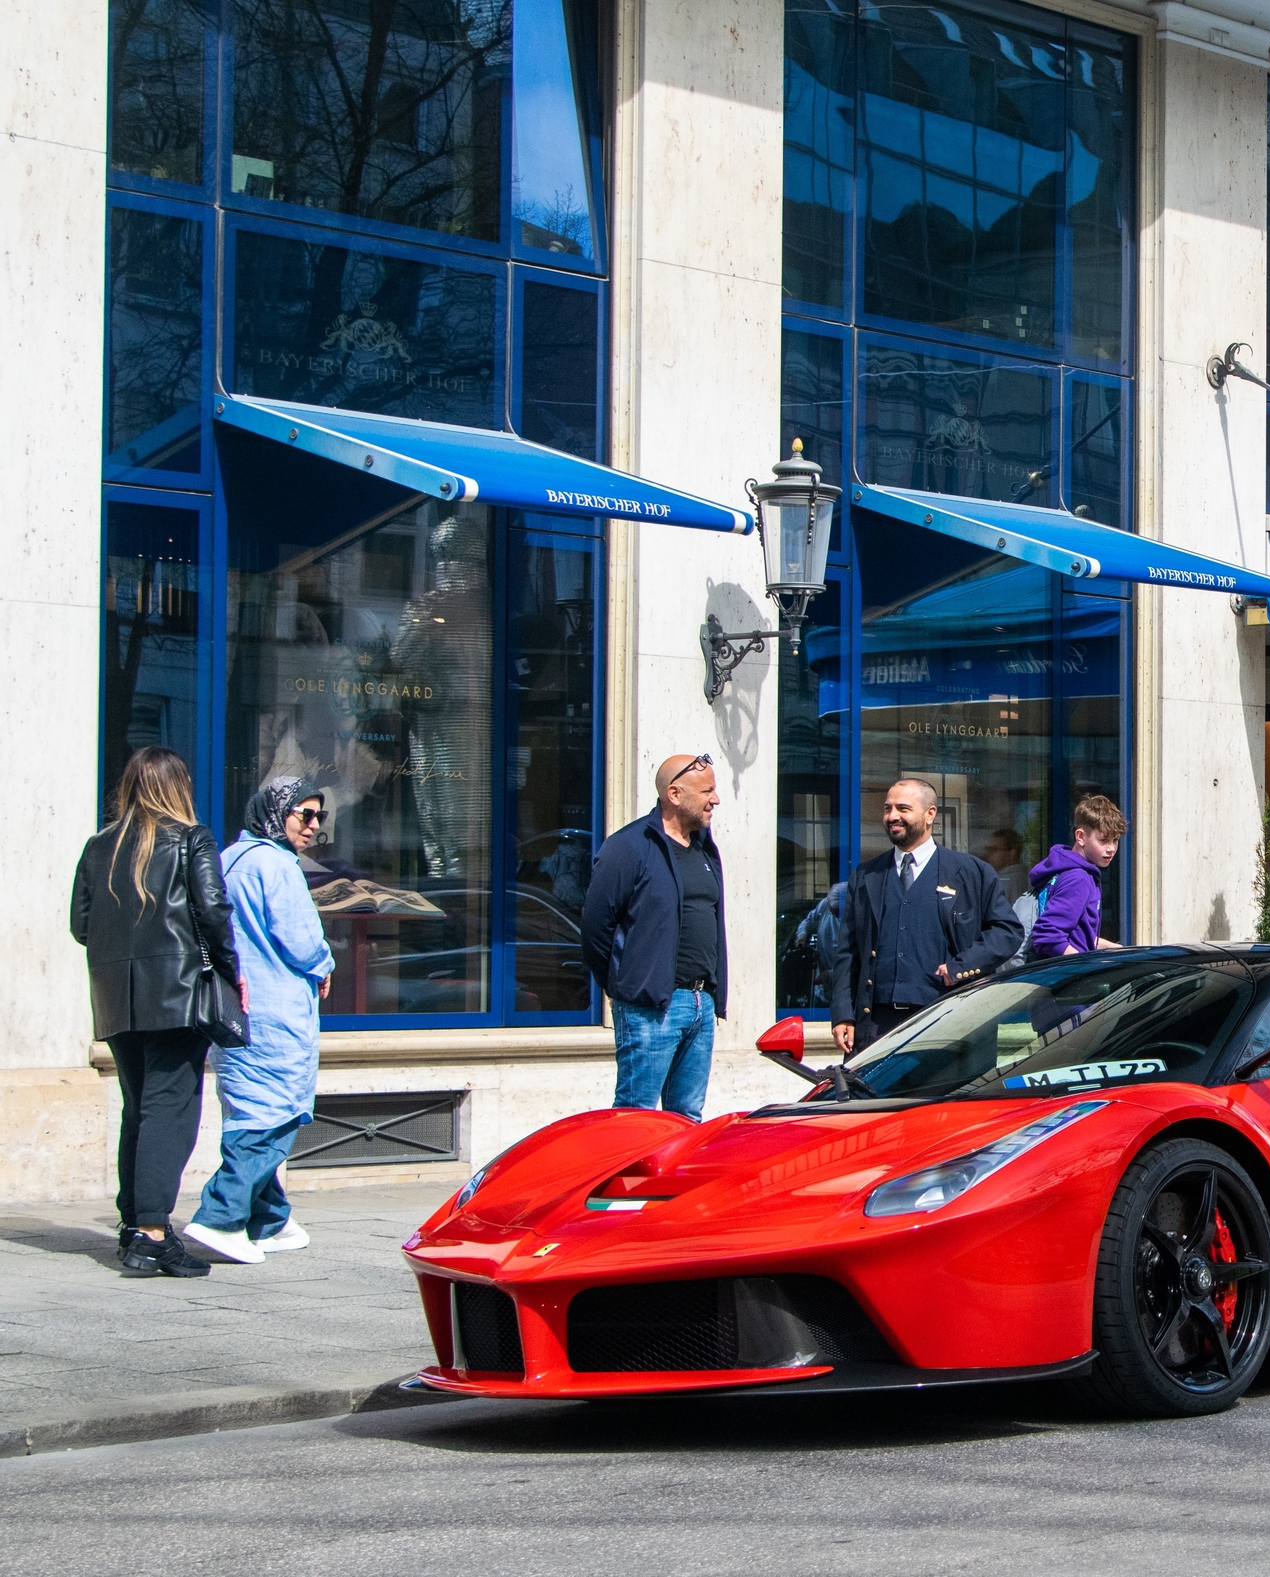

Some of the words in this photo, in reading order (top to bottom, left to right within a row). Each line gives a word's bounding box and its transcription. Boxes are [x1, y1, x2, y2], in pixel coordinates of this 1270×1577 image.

[259, 349, 417, 386] BAYERISCHER
[429, 374, 474, 393] HOF
[882, 446, 997, 474] BAYERISCHER
[546, 489, 641, 514] BAYERISCHER
[643, 501, 671, 517] HOF
[1147, 566, 1215, 586] BAYERISCHER
[1216, 575, 1236, 588] HOF
[295, 677, 325, 692] OLE
[936, 685, 980, 695] CELEBRATING
[909, 721, 931, 734] OLE
[1027, 1073, 1051, 1087] M
